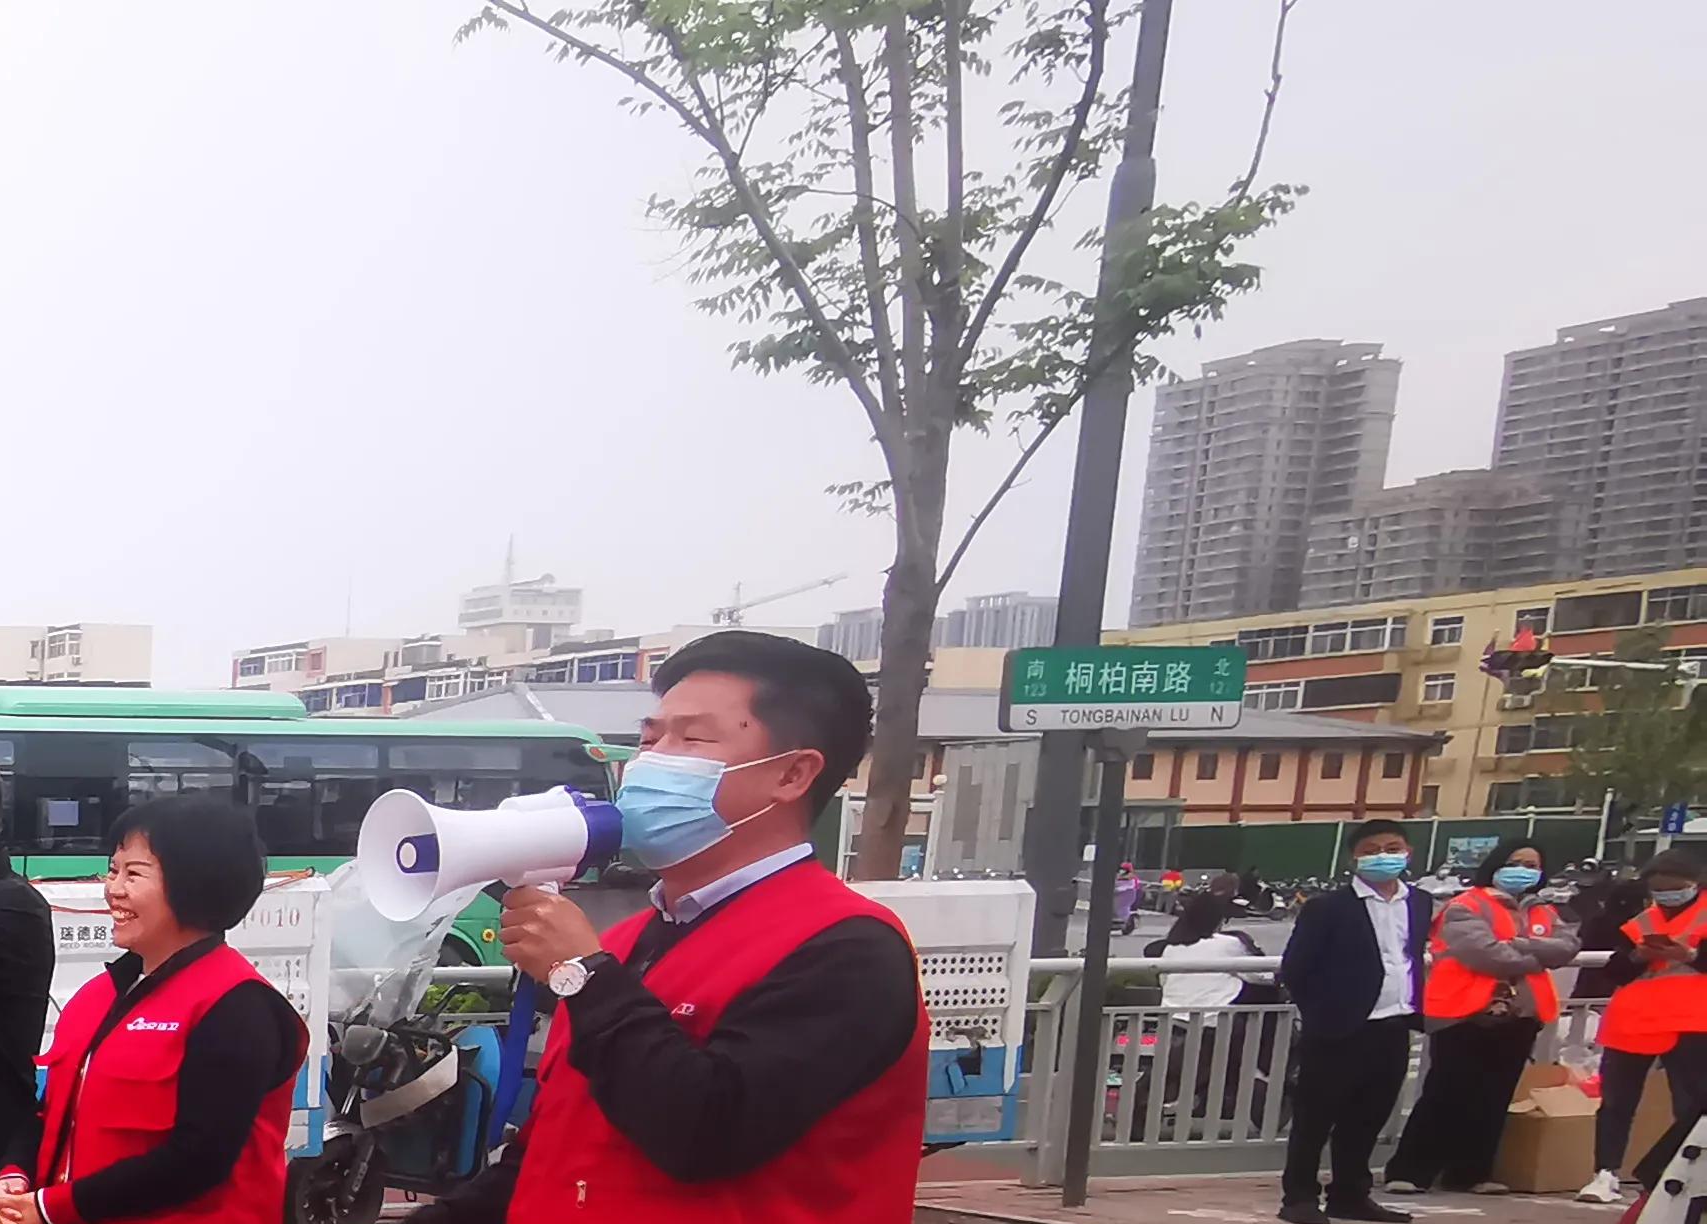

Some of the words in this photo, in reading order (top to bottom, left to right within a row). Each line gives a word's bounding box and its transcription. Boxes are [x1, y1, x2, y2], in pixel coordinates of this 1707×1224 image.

[1027, 659, 1046, 680] 南
[1212, 658, 1232, 677] 北
[1065, 660, 1192, 696] 桐柏南路
[1210, 680, 1231, 695] 12
[1026, 709, 1038, 726] S
[1060, 708, 1163, 725] TONGBAINAN
[1170, 708, 1190, 722] LU
[1210, 706, 1224, 723] N
[60, 925, 114, 942] 瑞德路
